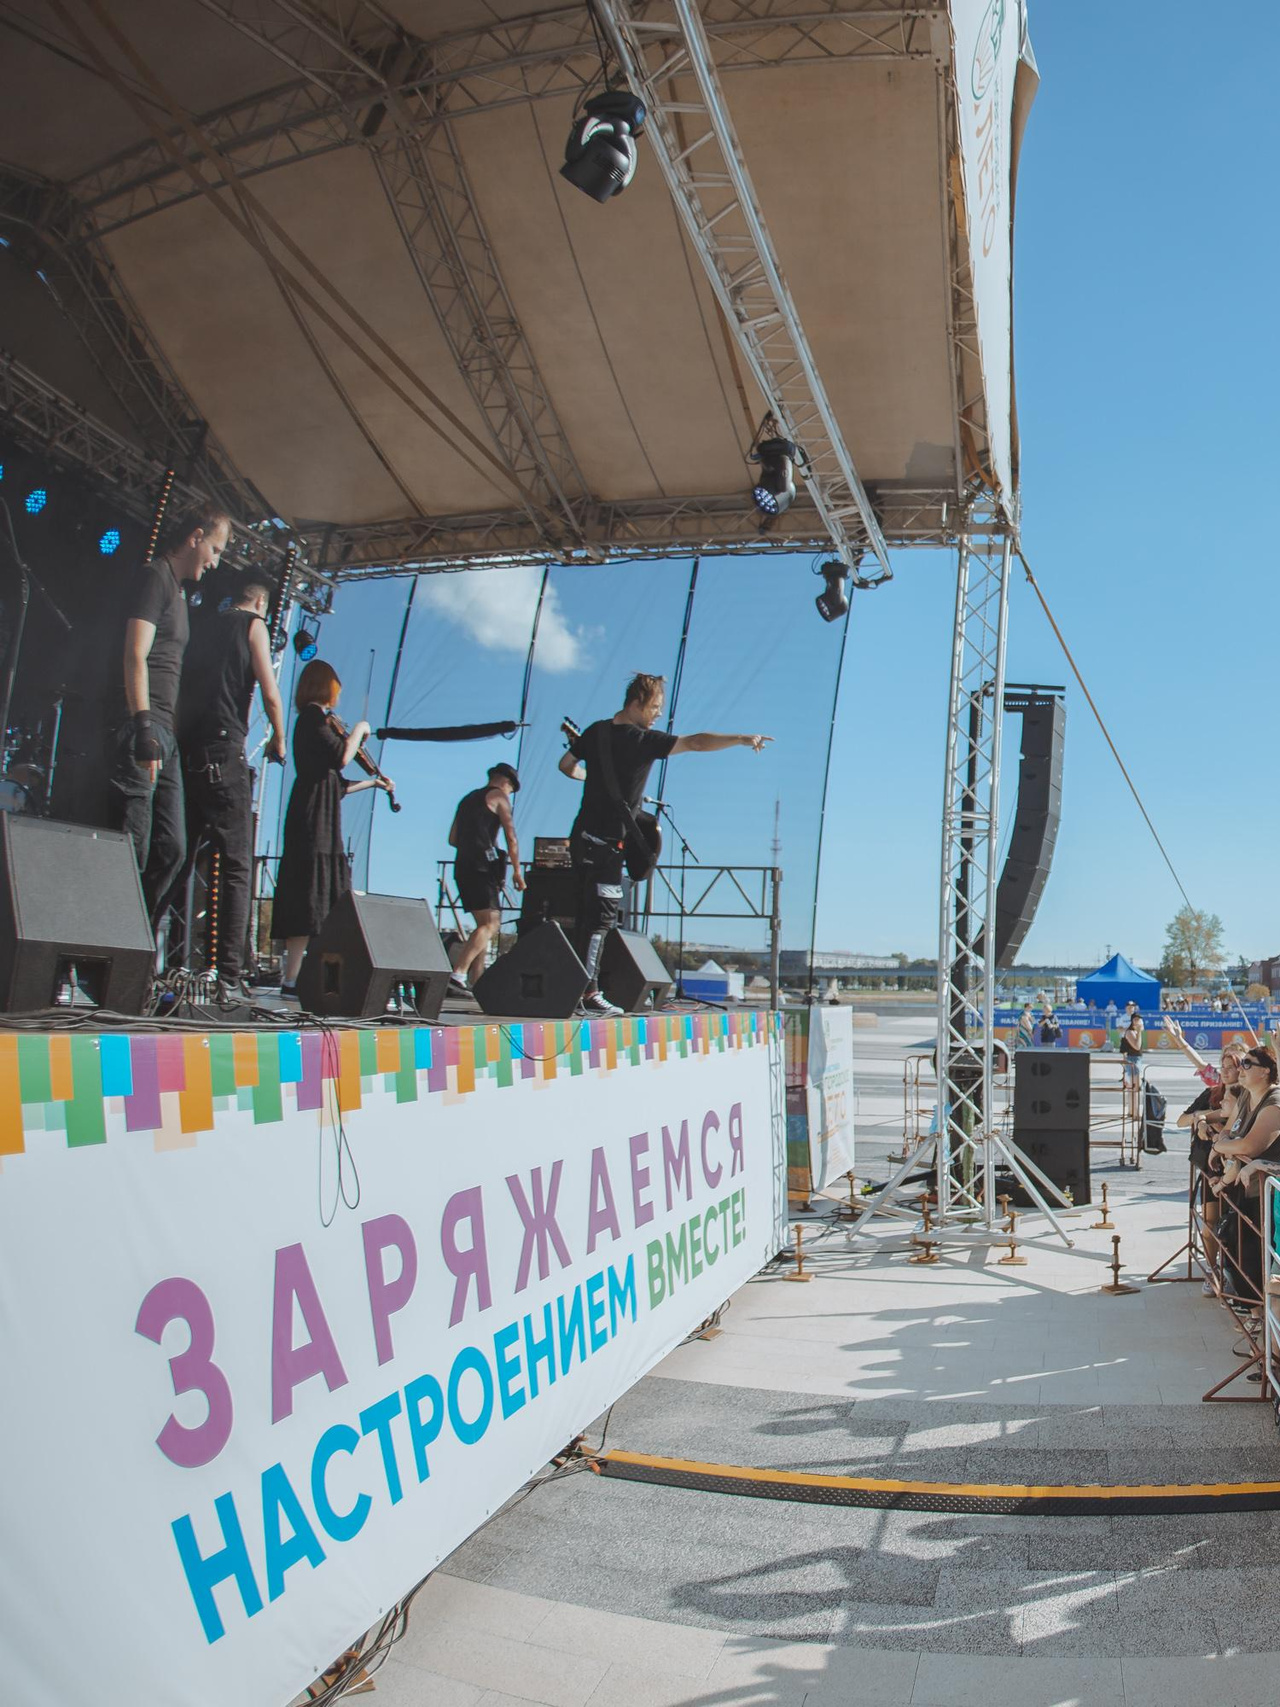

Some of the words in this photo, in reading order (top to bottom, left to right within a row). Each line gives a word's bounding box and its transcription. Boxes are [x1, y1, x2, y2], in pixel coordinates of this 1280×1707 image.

[134, 1102, 744, 1469] ЗАРЯЖАЕМСЯ
[171, 1254, 638, 1645] НАСТРОЕНИЕМ
[646, 1187, 746, 1311] ВМЕСТЕ!
